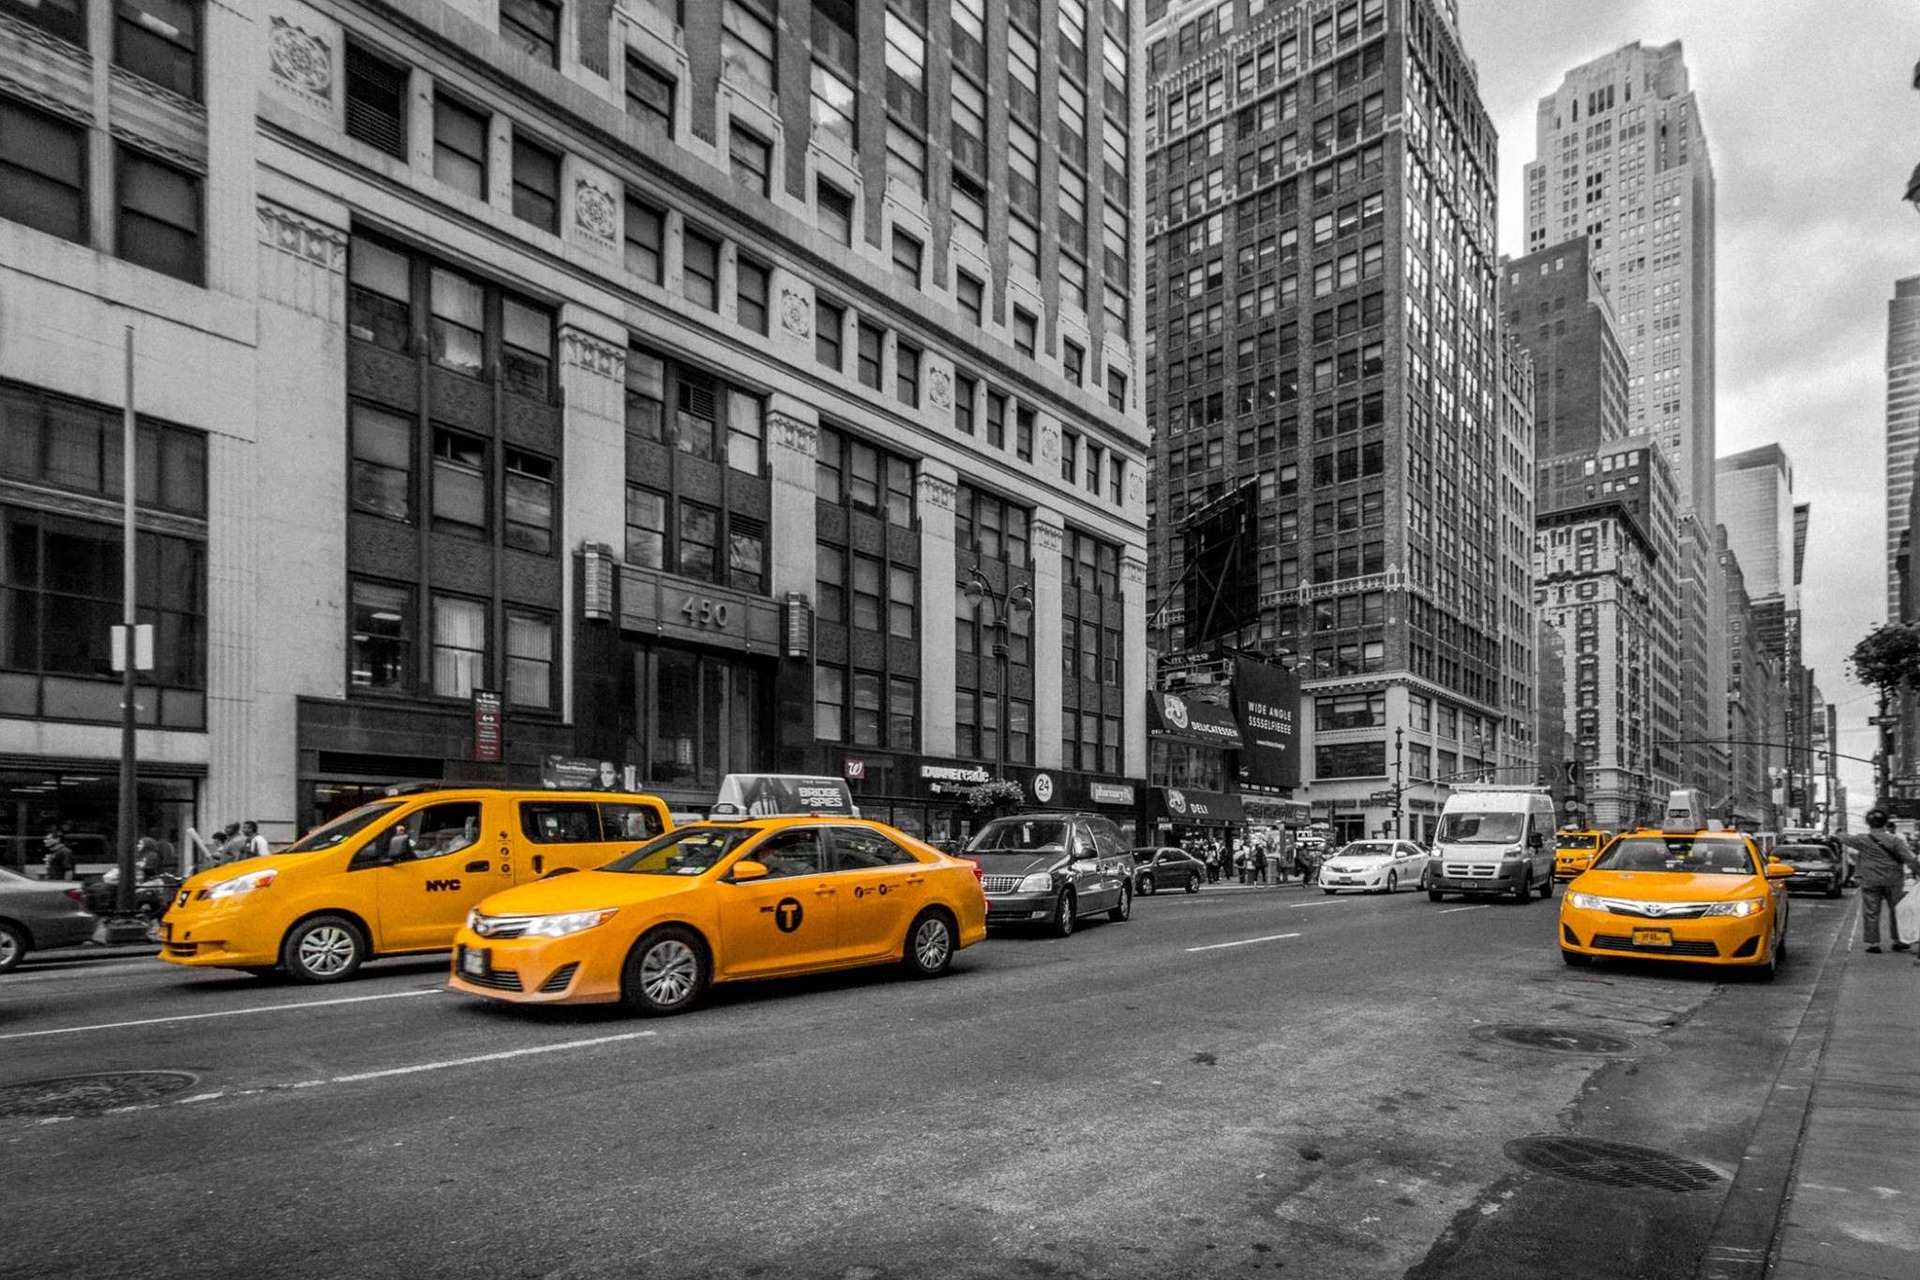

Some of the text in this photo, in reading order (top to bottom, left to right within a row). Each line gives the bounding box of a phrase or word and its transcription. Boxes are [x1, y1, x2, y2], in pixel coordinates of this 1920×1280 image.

[682, 597, 727, 627] 450
[1248, 701, 1291, 721] WIDE ANGLE
[1191, 721, 1238, 736] DELICATESSEN
[1039, 779, 1049, 791] 24
[799, 788, 841, 797] BRIDGE
[810, 797, 843, 807] SPIES
[1190, 803, 1208, 814] DELI
[426, 879, 461, 892] NYC
